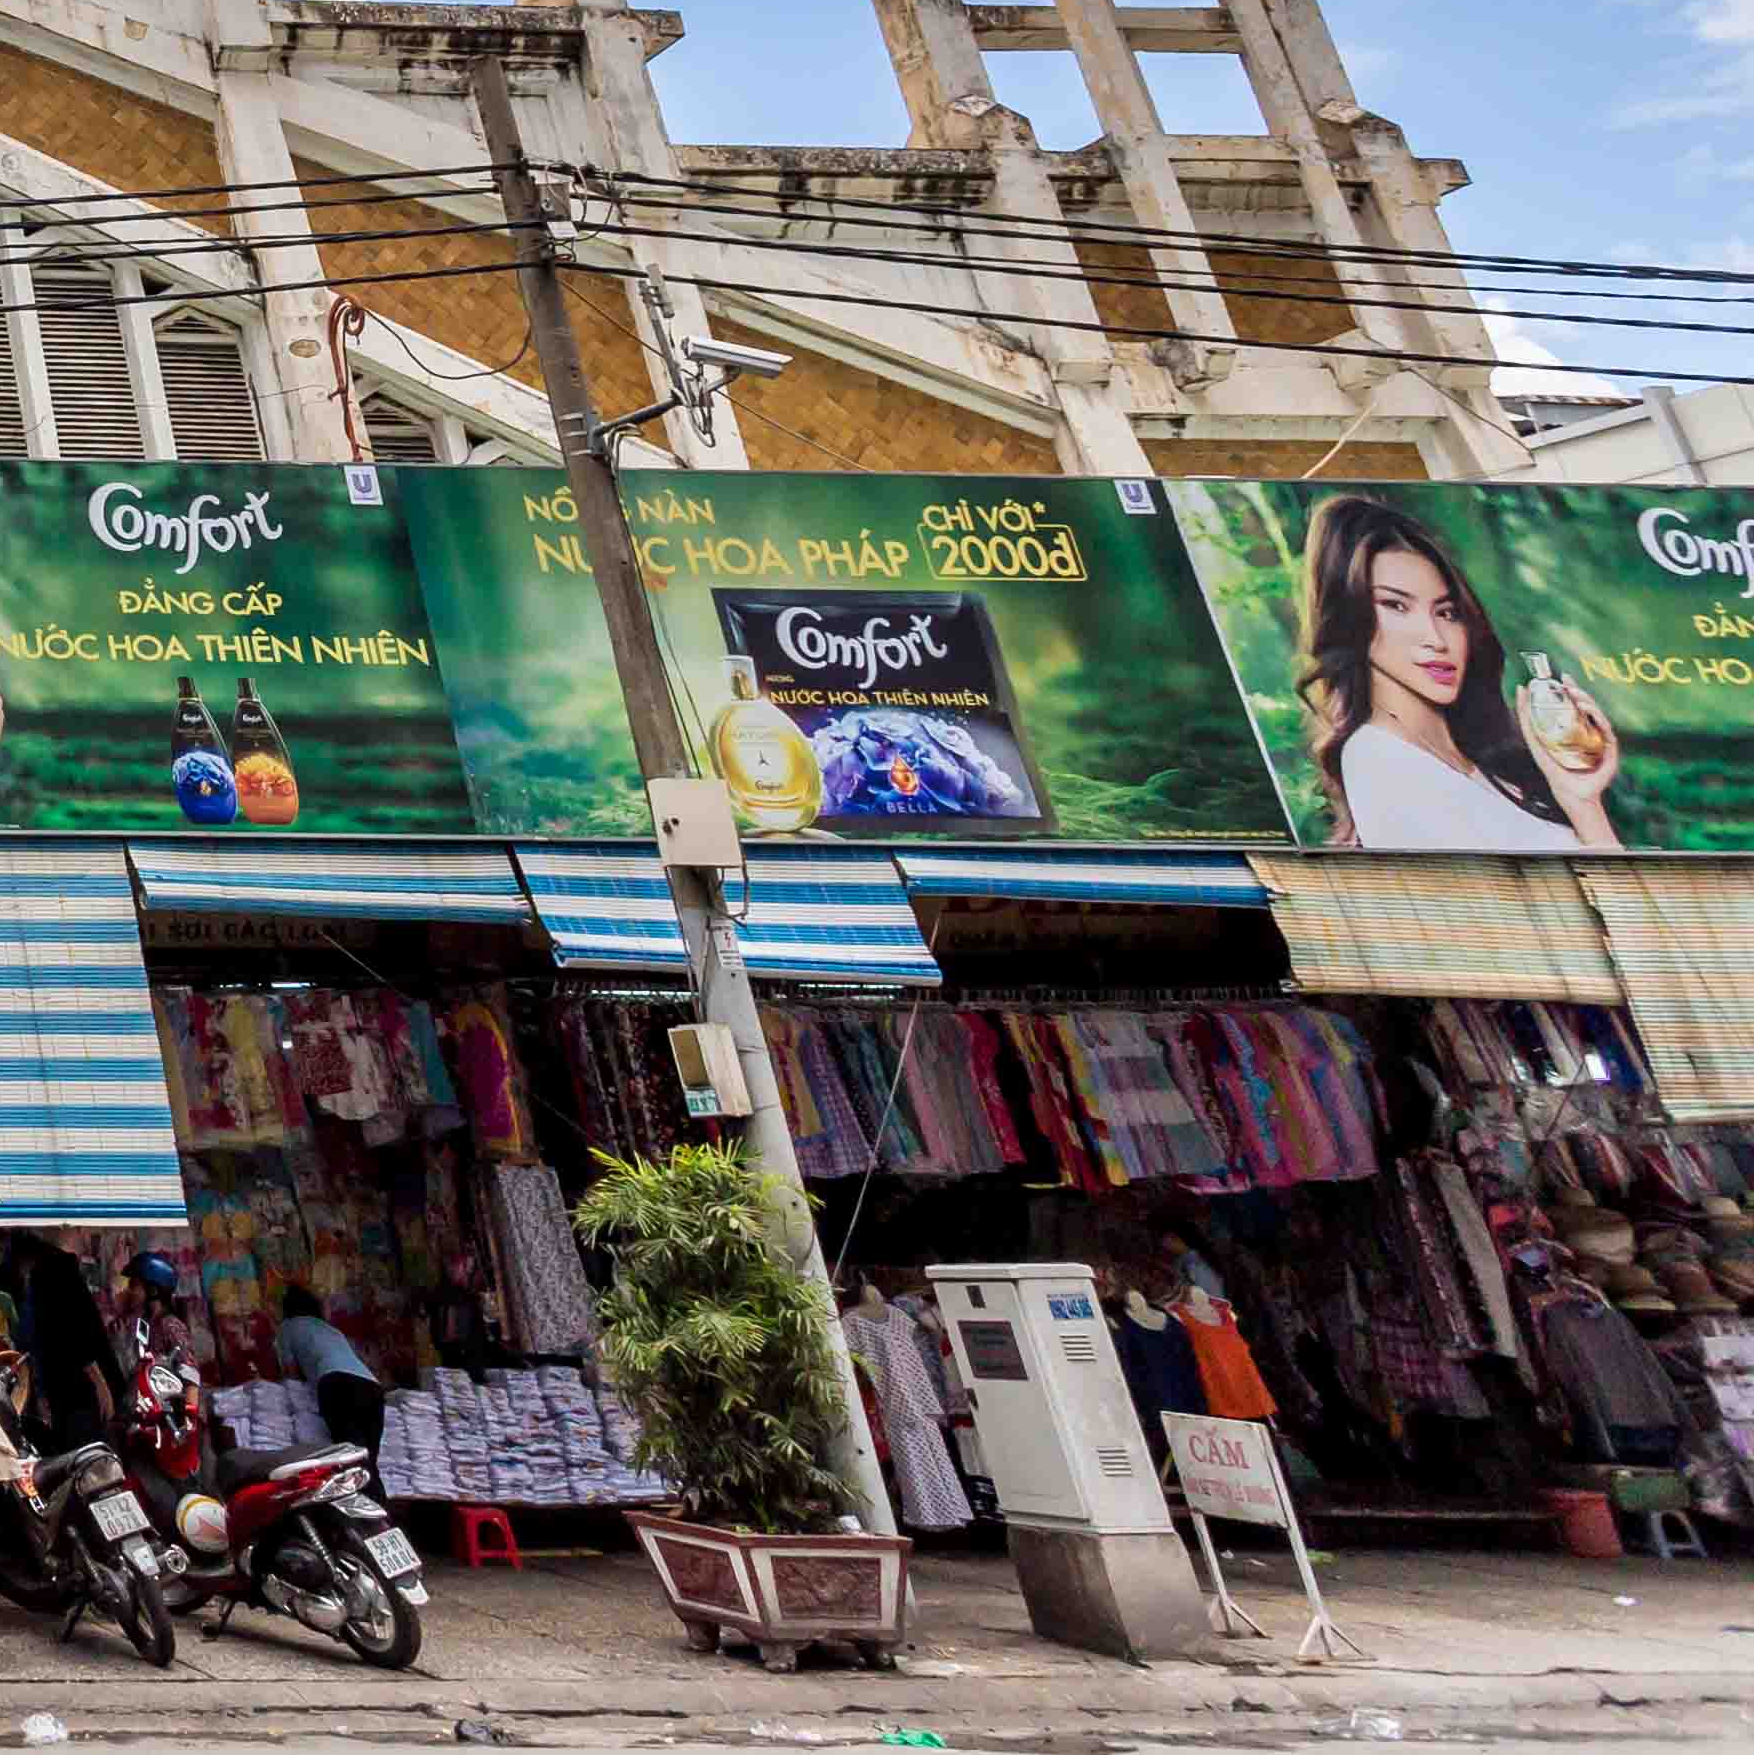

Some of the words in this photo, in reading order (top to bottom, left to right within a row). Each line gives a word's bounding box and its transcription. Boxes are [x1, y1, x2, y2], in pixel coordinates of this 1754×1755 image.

[637, 489, 716, 525] NÀN
[921, 499, 973, 532] CHỈ
[87, 482, 284, 575] Comfort
[684, 536, 792, 577] HOA
[797, 528, 909, 577] PHÁP
[931, 534, 1080, 577] 2000đ
[117, 577, 215, 615] ĐẲNG
[222, 581, 283, 616] CẤP
[107, 633, 193, 662] HOA
[195, 627, 302, 664] THIÊN
[309, 629, 431, 665] NHIÊN
[775, 605, 948, 689] Comfort
[1578, 646, 1693, 685] NƯỚC
[770, 688, 825, 705] NƯỚC
[829, 691, 870, 706] HOA
[873, 689, 929, 707] THIÊN
[932, 690, 990, 707] NHIÊN
[886, 801, 939, 815] BELLA
